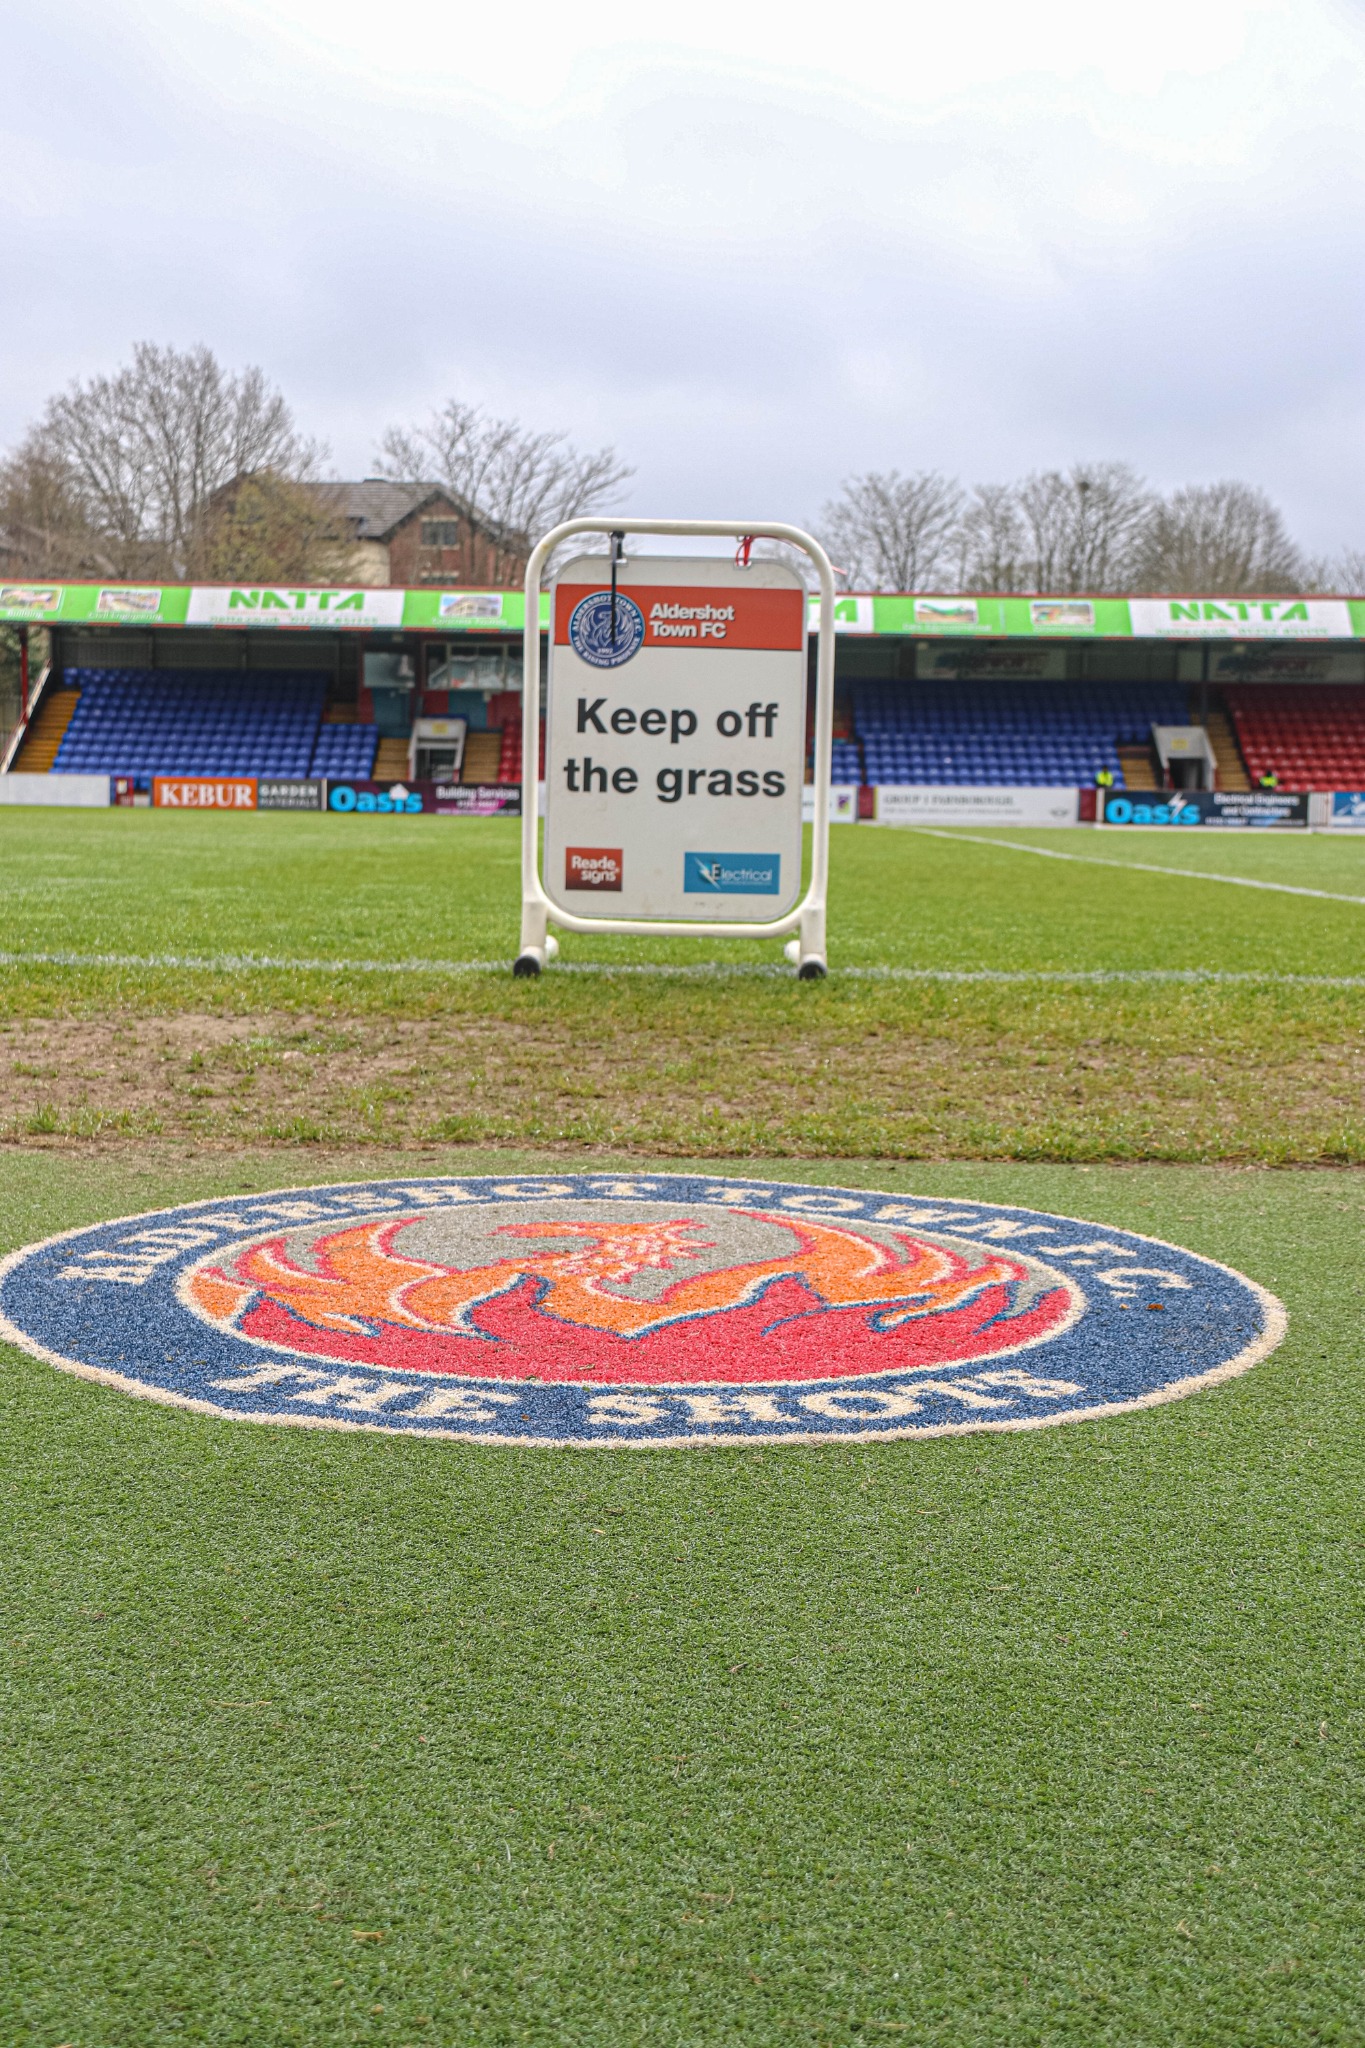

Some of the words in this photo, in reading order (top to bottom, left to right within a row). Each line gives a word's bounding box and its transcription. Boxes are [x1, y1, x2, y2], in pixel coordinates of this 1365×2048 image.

[228, 590, 366, 610] NATTA
[650, 603, 734, 621] Aldershot
[1169, 602, 1310, 621] NATTA
[650, 621, 697, 637] Town
[701, 622, 727, 638] FC
[577, 698, 698, 744] Keep
[717, 702, 779, 738] off
[564, 757, 638, 794] the
[656, 767, 786, 803] grass
[160, 783, 253, 807] KEBUR
[259, 784, 318, 797] GARDEN
[329, 785, 424, 813] Oasis
[435, 785, 477, 801] Building
[477, 786, 520, 800] Services
[260, 797, 319, 808] MATERIALS
[1105, 796, 1200, 825] Oasis
[571, 855, 617, 870] Reade
[711, 863, 773, 881] Electrical
[580, 868, 617, 885] signs
[57, 1180, 658, 1286] ALDERSHOT
[704, 1185, 1060, 1240] TOWN
[209, 1362, 525, 1424] THE
[586, 1368, 1088, 1426] SHOTS
